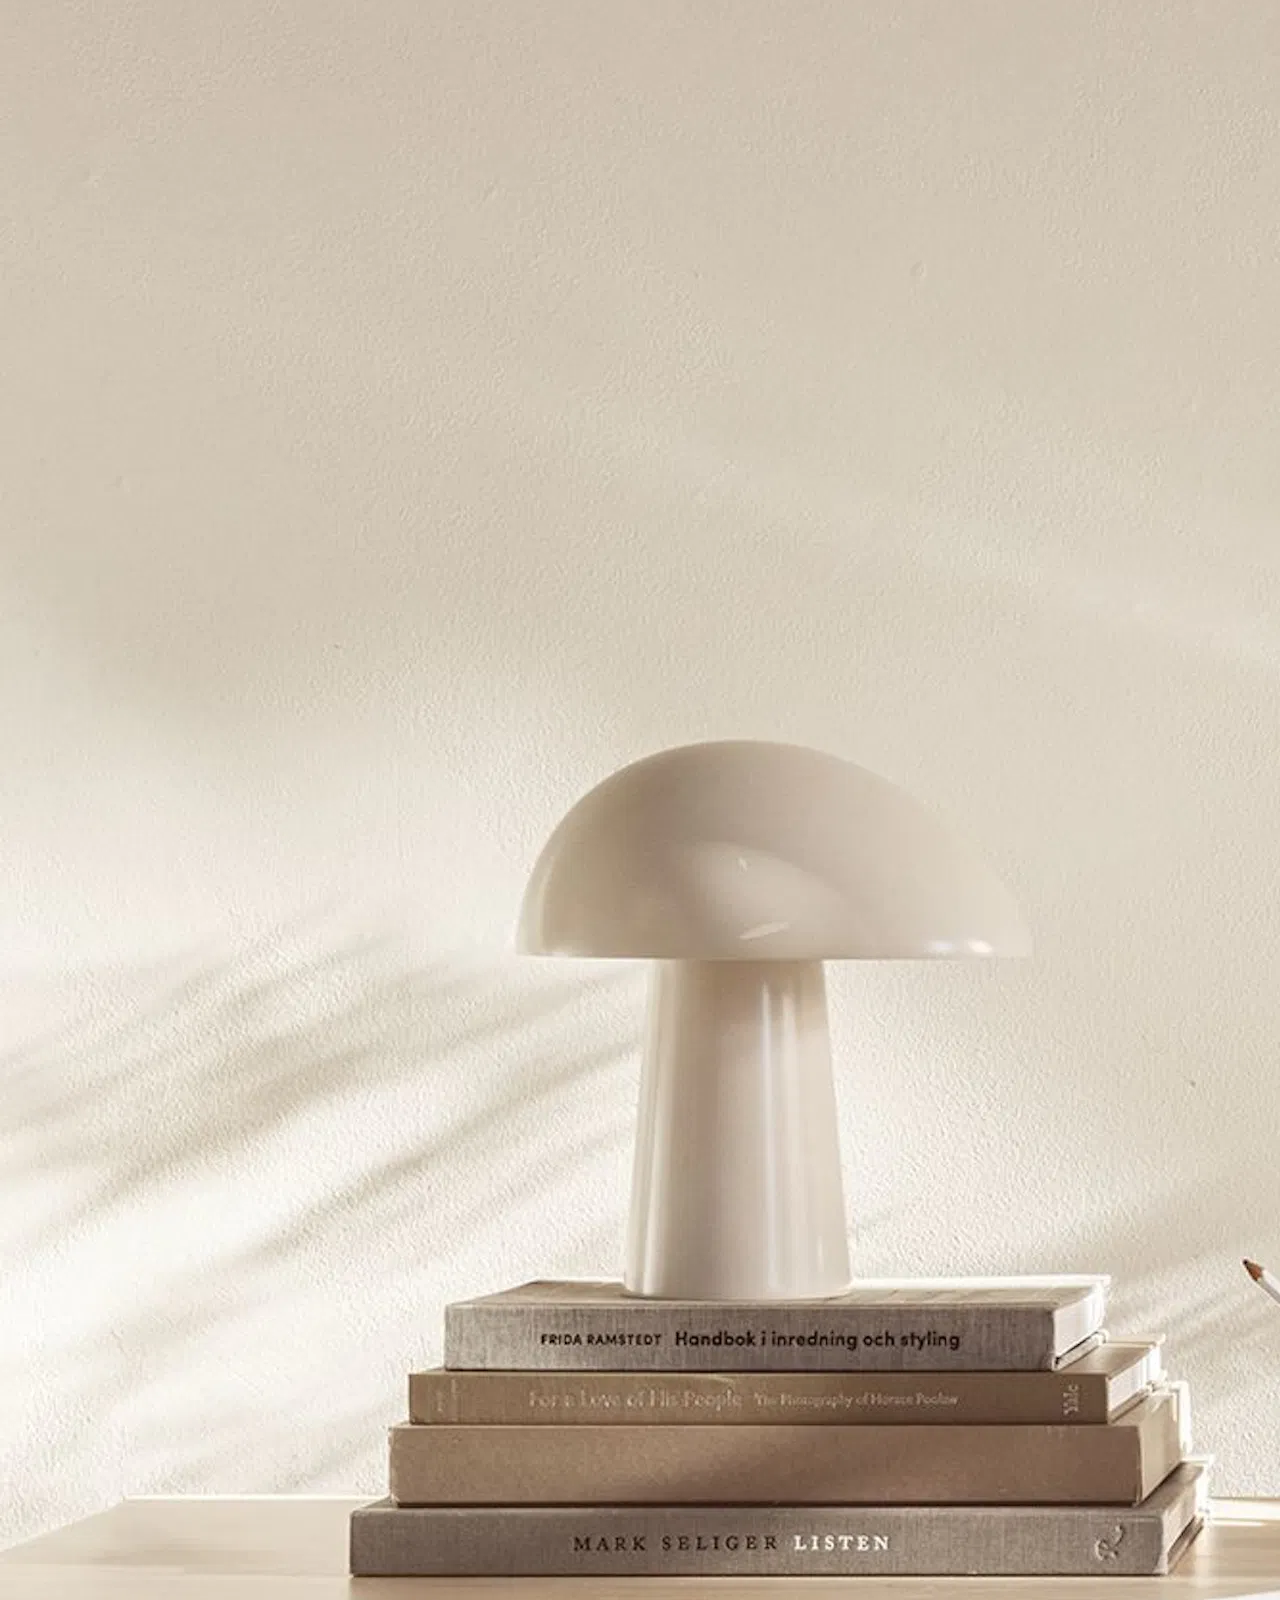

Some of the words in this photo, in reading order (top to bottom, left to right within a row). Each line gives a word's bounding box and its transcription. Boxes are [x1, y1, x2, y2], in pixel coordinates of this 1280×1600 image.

[541, 1333, 582, 1347] FRIDA
[587, 1333, 662, 1347] RAMSTEDT
[675, 1330, 757, 1347] Handbok
[761, 1330, 766, 1347] i
[771, 1330, 858, 1350] inredning
[863, 1331, 895, 1347] och
[901, 1330, 961, 1350] styling
[683, 1388, 743, 1411] People
[573, 1535, 647, 1551] MARK
[661, 1534, 779, 1551] SELIGER
[793, 1533, 890, 1551] LISTEN
